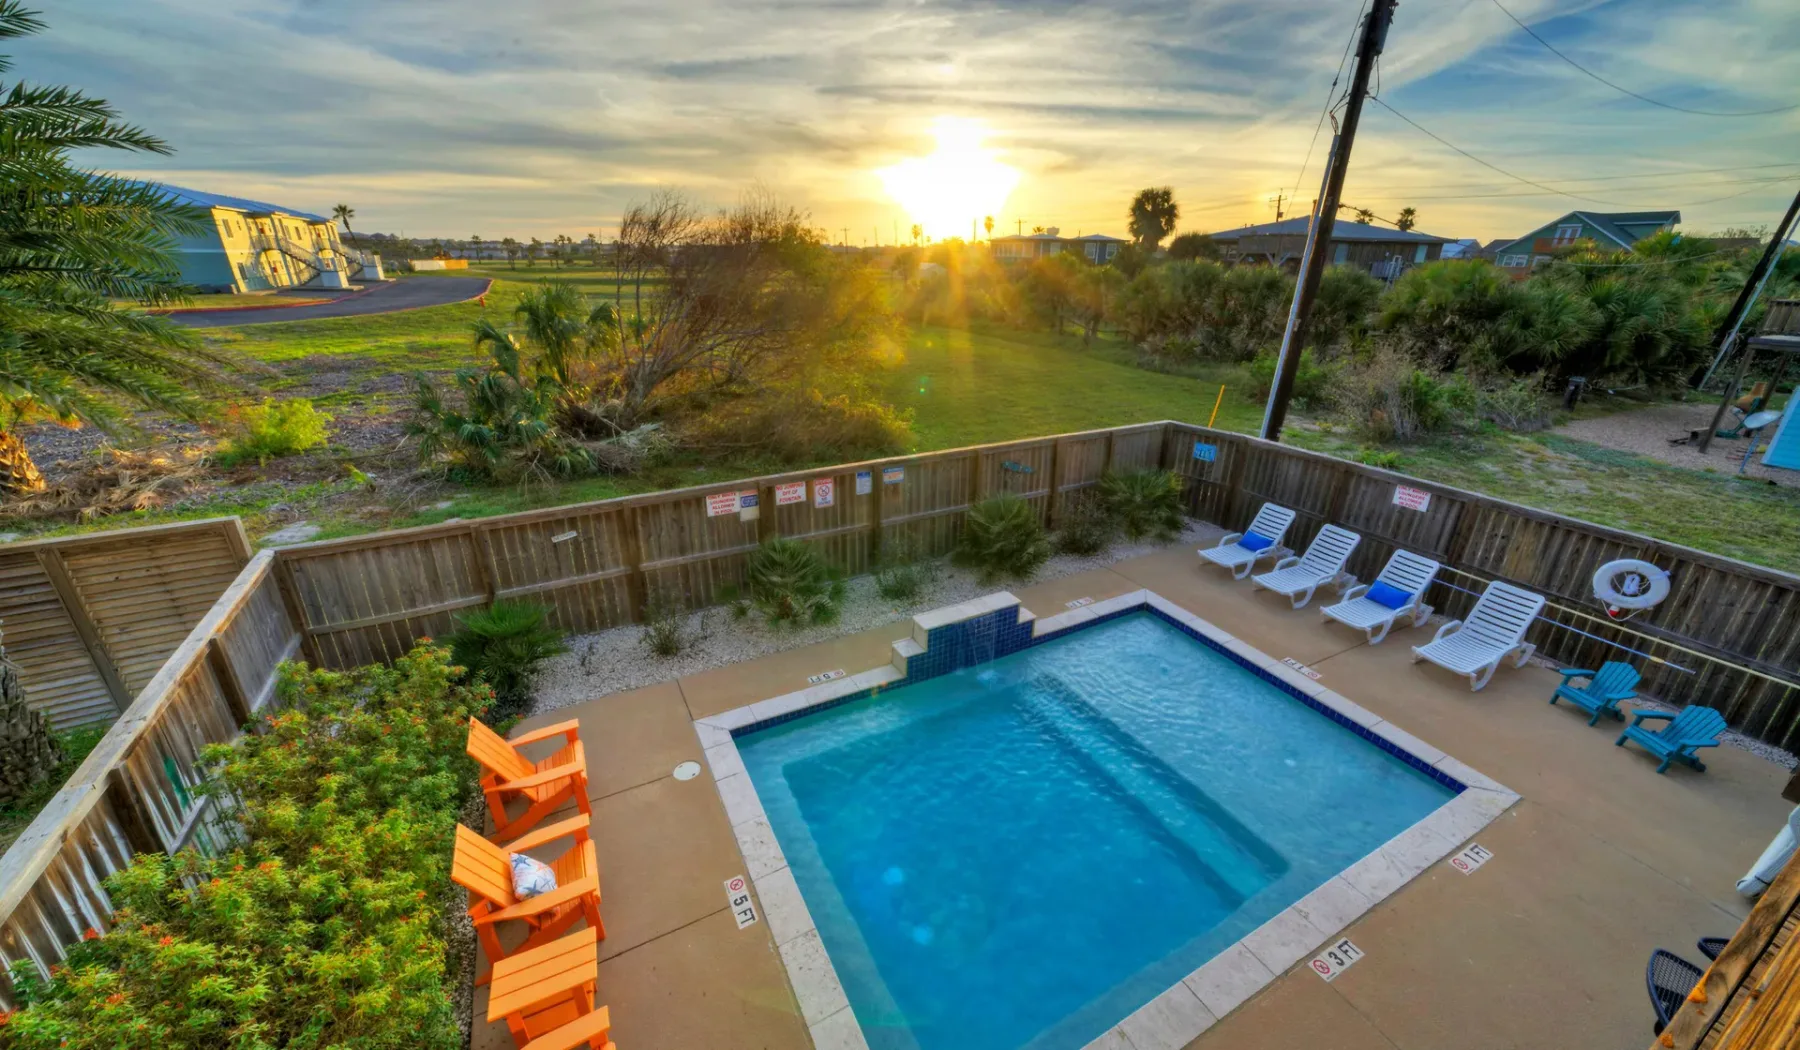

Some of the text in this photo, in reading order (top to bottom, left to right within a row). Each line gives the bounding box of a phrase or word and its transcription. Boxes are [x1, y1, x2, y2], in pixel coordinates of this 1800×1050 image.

[1464, 844, 1490, 864] 1 FT
[733, 894, 756, 924] 5 FT
[1327, 940, 1360, 967] 3 FT
